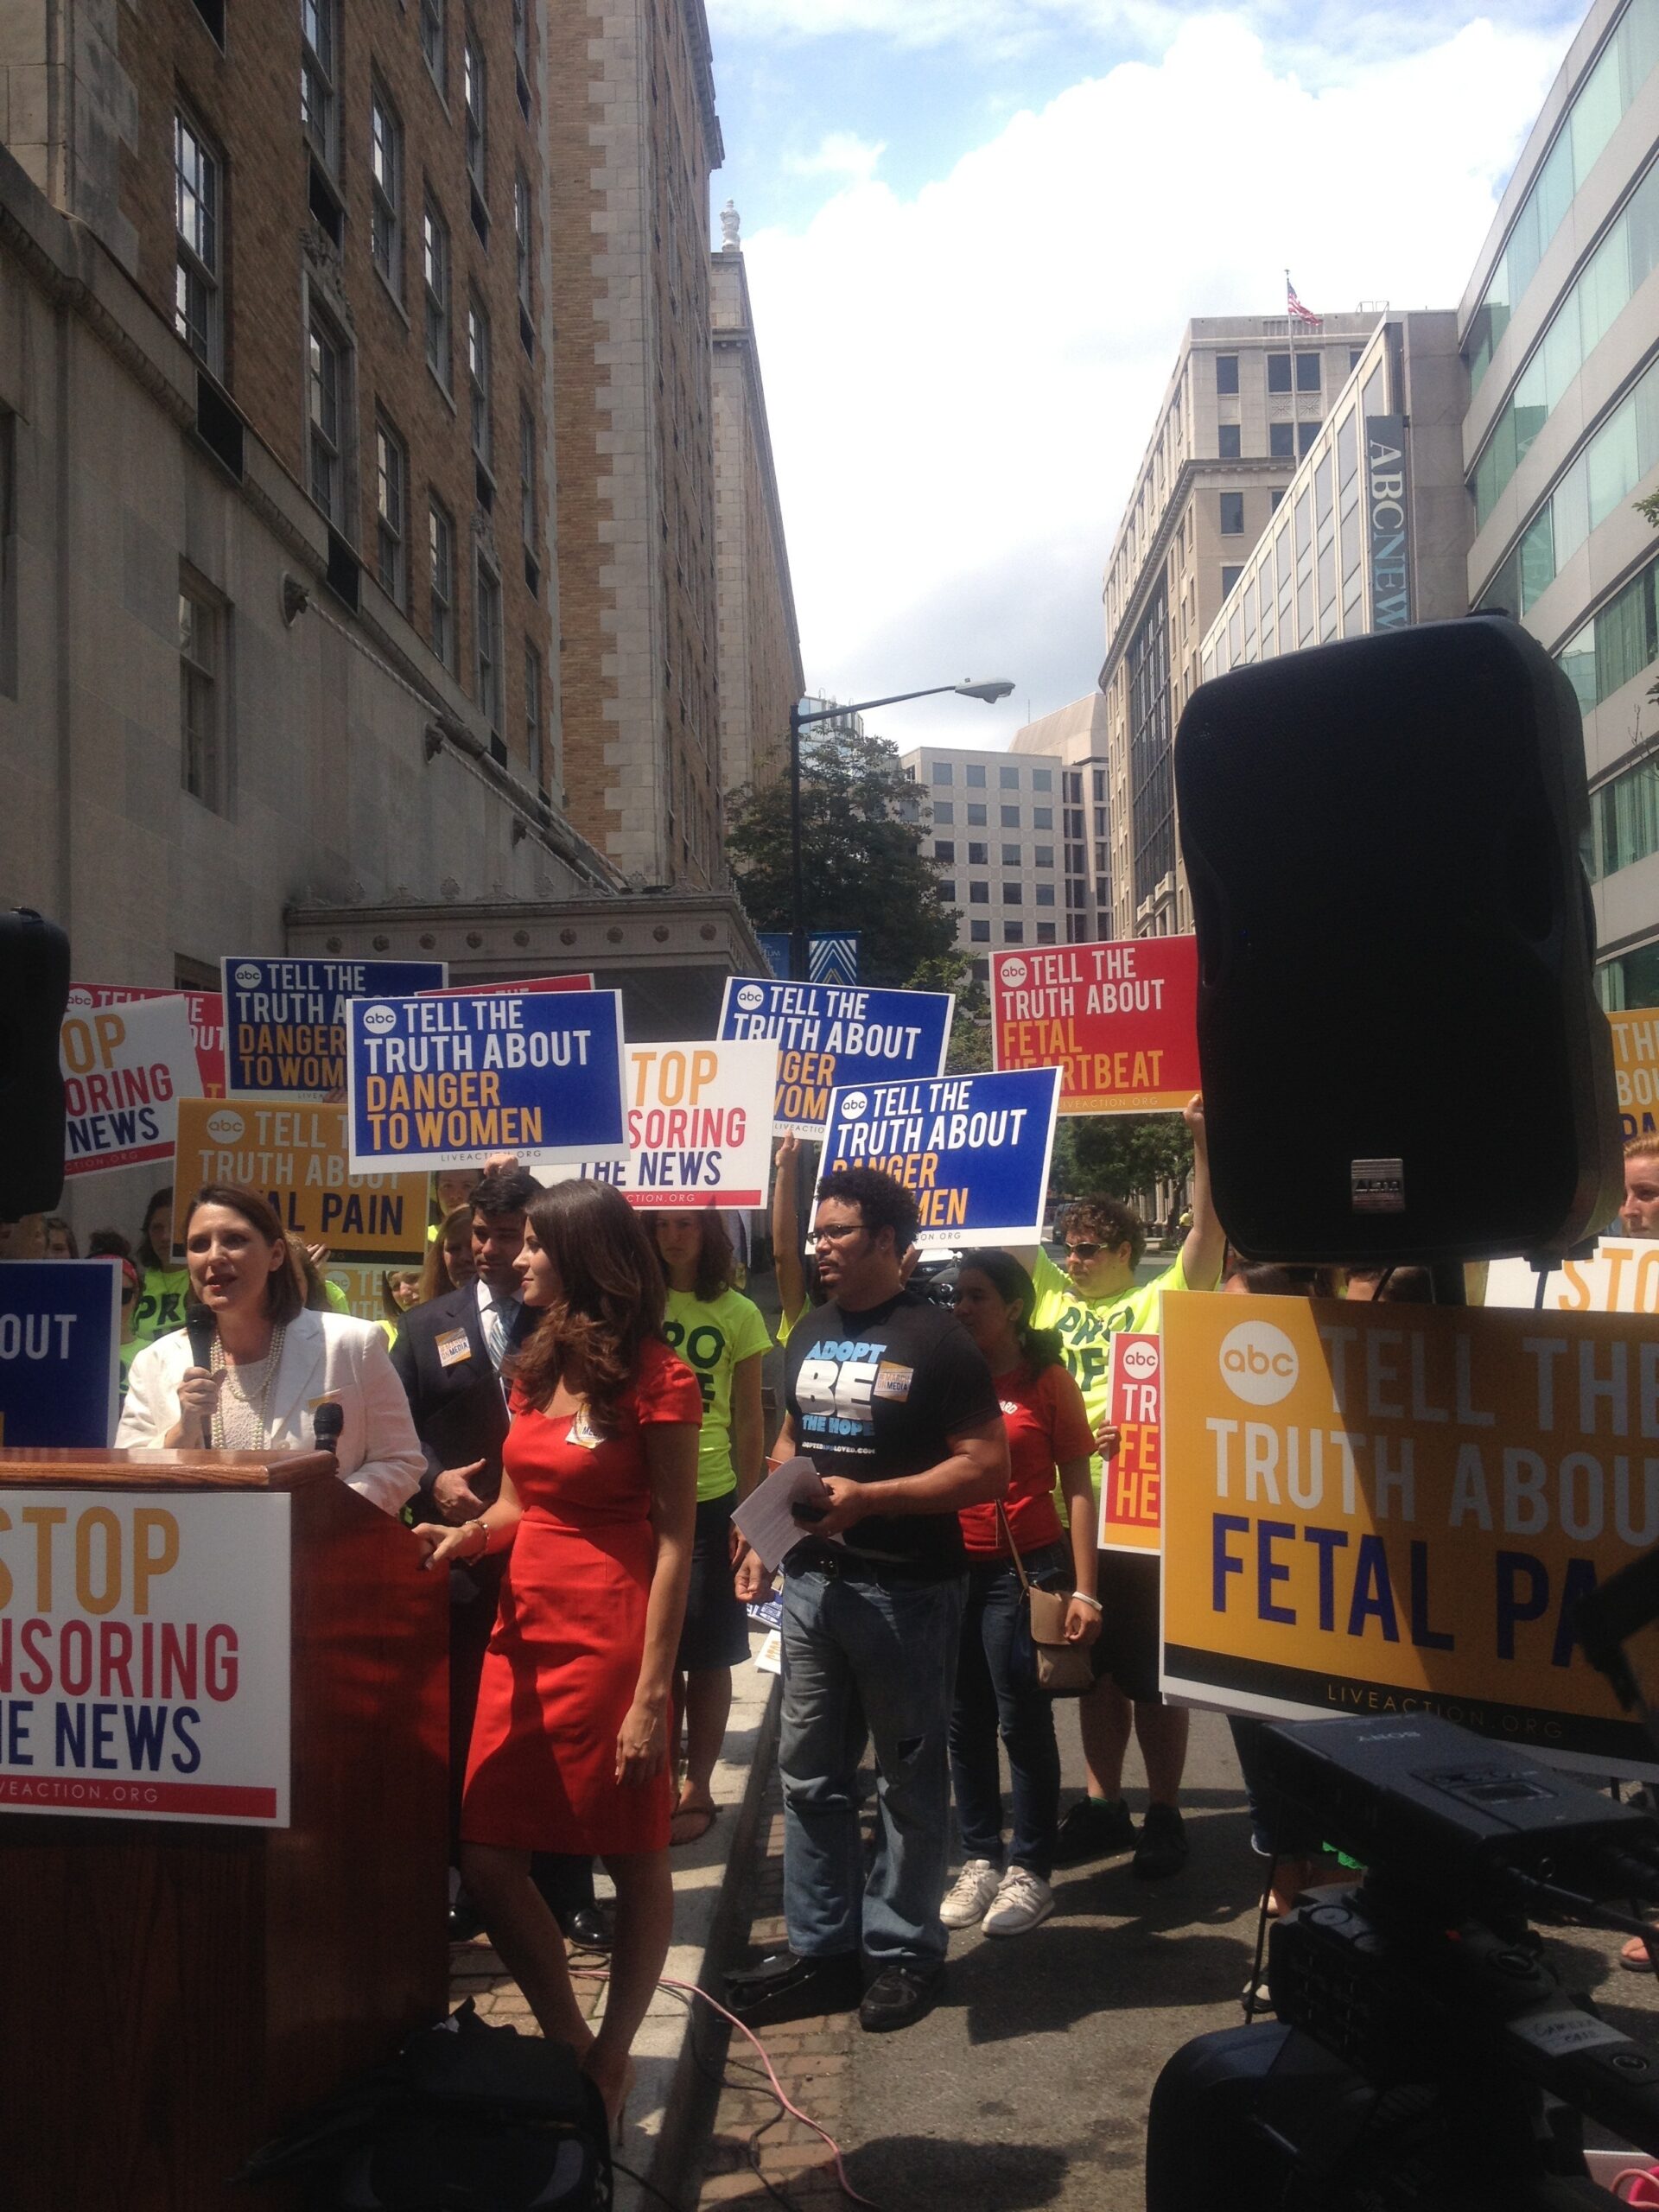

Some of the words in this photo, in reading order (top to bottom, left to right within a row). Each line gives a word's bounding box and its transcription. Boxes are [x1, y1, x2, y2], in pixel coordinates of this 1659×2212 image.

[236, 970, 260, 981] abc
[267, 963, 320, 990] TELL
[323, 965, 366, 992] THE
[1002, 965, 1025, 977] abc
[1030, 953, 1083, 986] TELL
[1092, 948, 1136, 981] THE
[236, 992, 325, 1024] TRUTH
[739, 991, 762, 1002] abc
[770, 987, 820, 1016] TELL
[826, 990, 870, 1020] THE
[1002, 986, 1075, 1020] TRUTH
[1087, 979, 1165, 1014] ABOUT
[365, 1012, 395, 1024] abc
[403, 1001, 467, 1033] TELL
[472, 999, 524, 1030] THE
[238, 1024, 346, 1056] DANGER
[364, 1034, 473, 1074] TRUTH
[483, 1030, 591, 1070] ABOUT
[734, 1013, 821, 1052] TRUTH
[824, 1021, 922, 1059] ABOUT
[1003, 1018, 1083, 1057] FETAL
[239, 1055, 273, 1086] TO
[277, 1056, 345, 1087] WOM
[632, 1050, 718, 1107] TOP
[366, 1071, 500, 1112] DANGER
[843, 1099, 866, 1110] abc
[873, 1085, 925, 1118] TELL
[930, 1080, 974, 1113] THE
[67, 1107, 159, 1154] NEWS
[255, 1111, 326, 1148] TELL
[367, 1112, 409, 1150] TO
[415, 1107, 543, 1148] WOMEN
[628, 1107, 747, 1149] SORING
[837, 1117, 925, 1159] TRUTH
[926, 1109, 1028, 1152] ABOUT
[199, 1150, 294, 1185] TRUTH
[639, 1150, 722, 1186] NEWS
[321, 1192, 404, 1236] PAIN
[1558, 1248, 1659, 1313] STO
[804, 1340, 888, 1363] ADOPT
[1125, 1351, 1156, 1367] abc
[1224, 1344, 1294, 1377] abc
[796, 1359, 879, 1421] BE
[1319, 1323, 1496, 1427] TELL
[802, 1414, 826, 1433] THE
[828, 1416, 875, 1436] HOPE
[1206, 1417, 1414, 1522] TRUTH
[1448, 1442, 1659, 1548] ABOU
[1212, 1512, 1455, 1651] FETAL
[0, 1618, 239, 1702] SORING
[55, 1701, 202, 1774] NEWS
